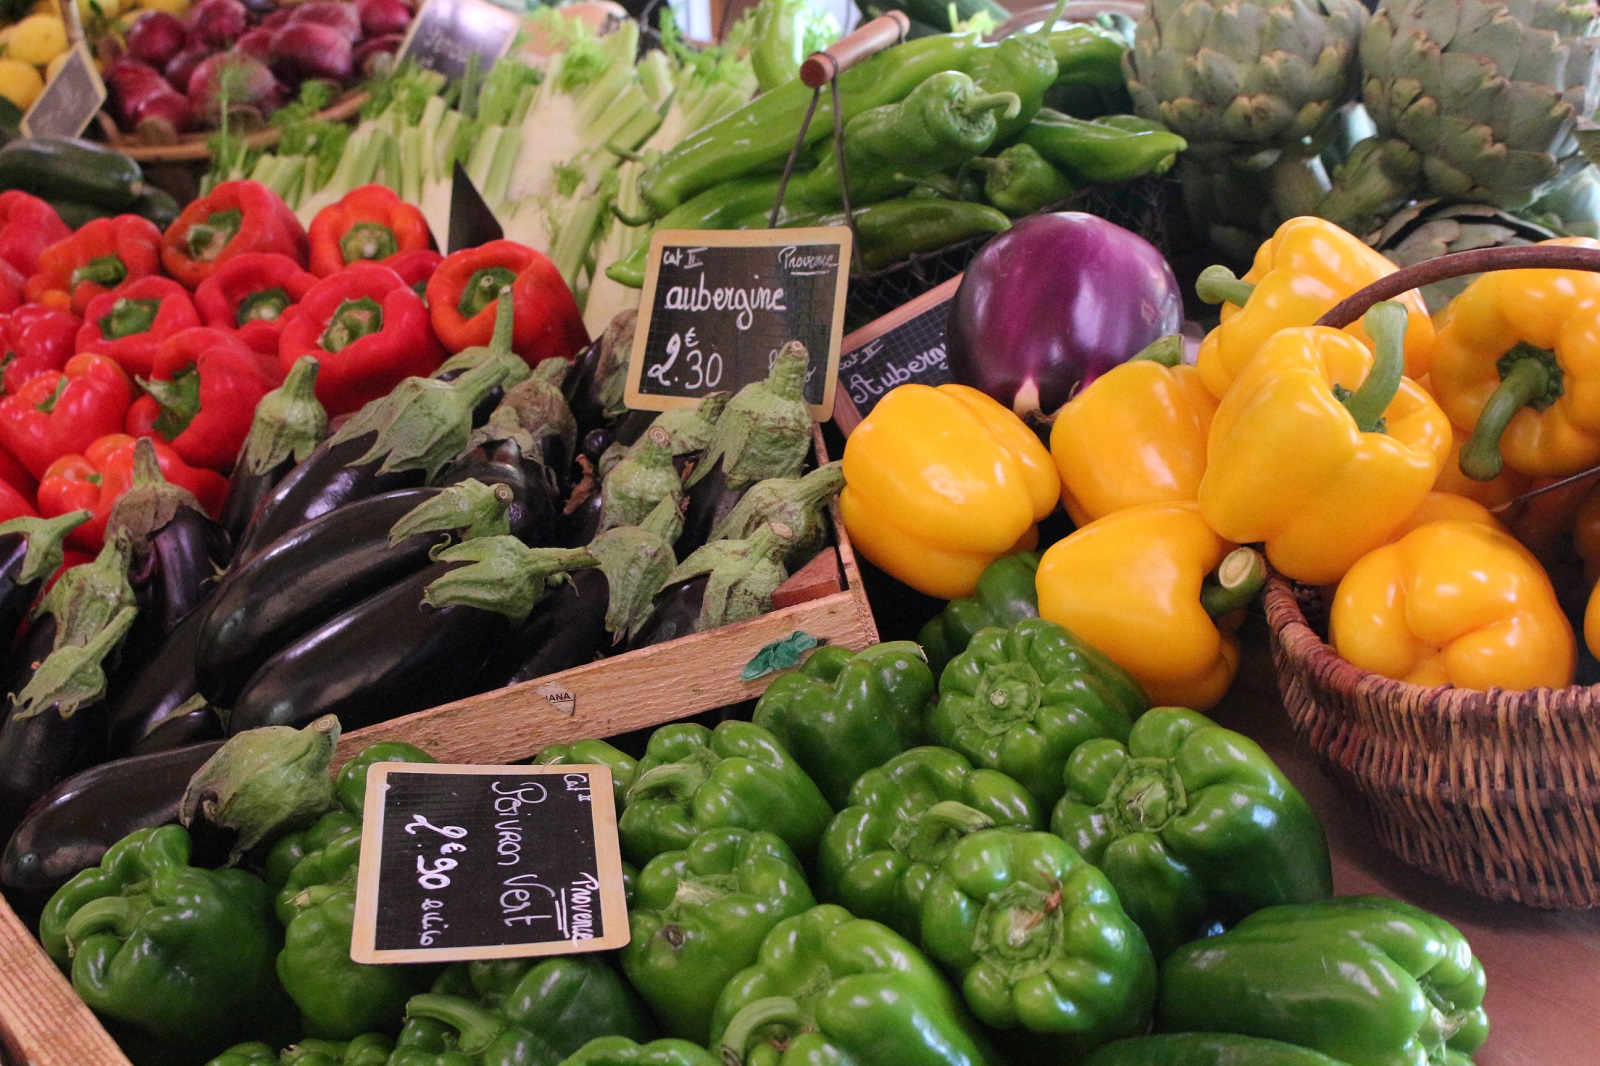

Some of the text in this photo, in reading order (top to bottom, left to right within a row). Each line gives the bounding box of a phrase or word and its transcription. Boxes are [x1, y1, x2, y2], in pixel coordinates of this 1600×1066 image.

[664, 272, 787, 330] aubergine
[491, 781, 556, 927] Poivron Vert
[569, 872, 600, 947] Provence
